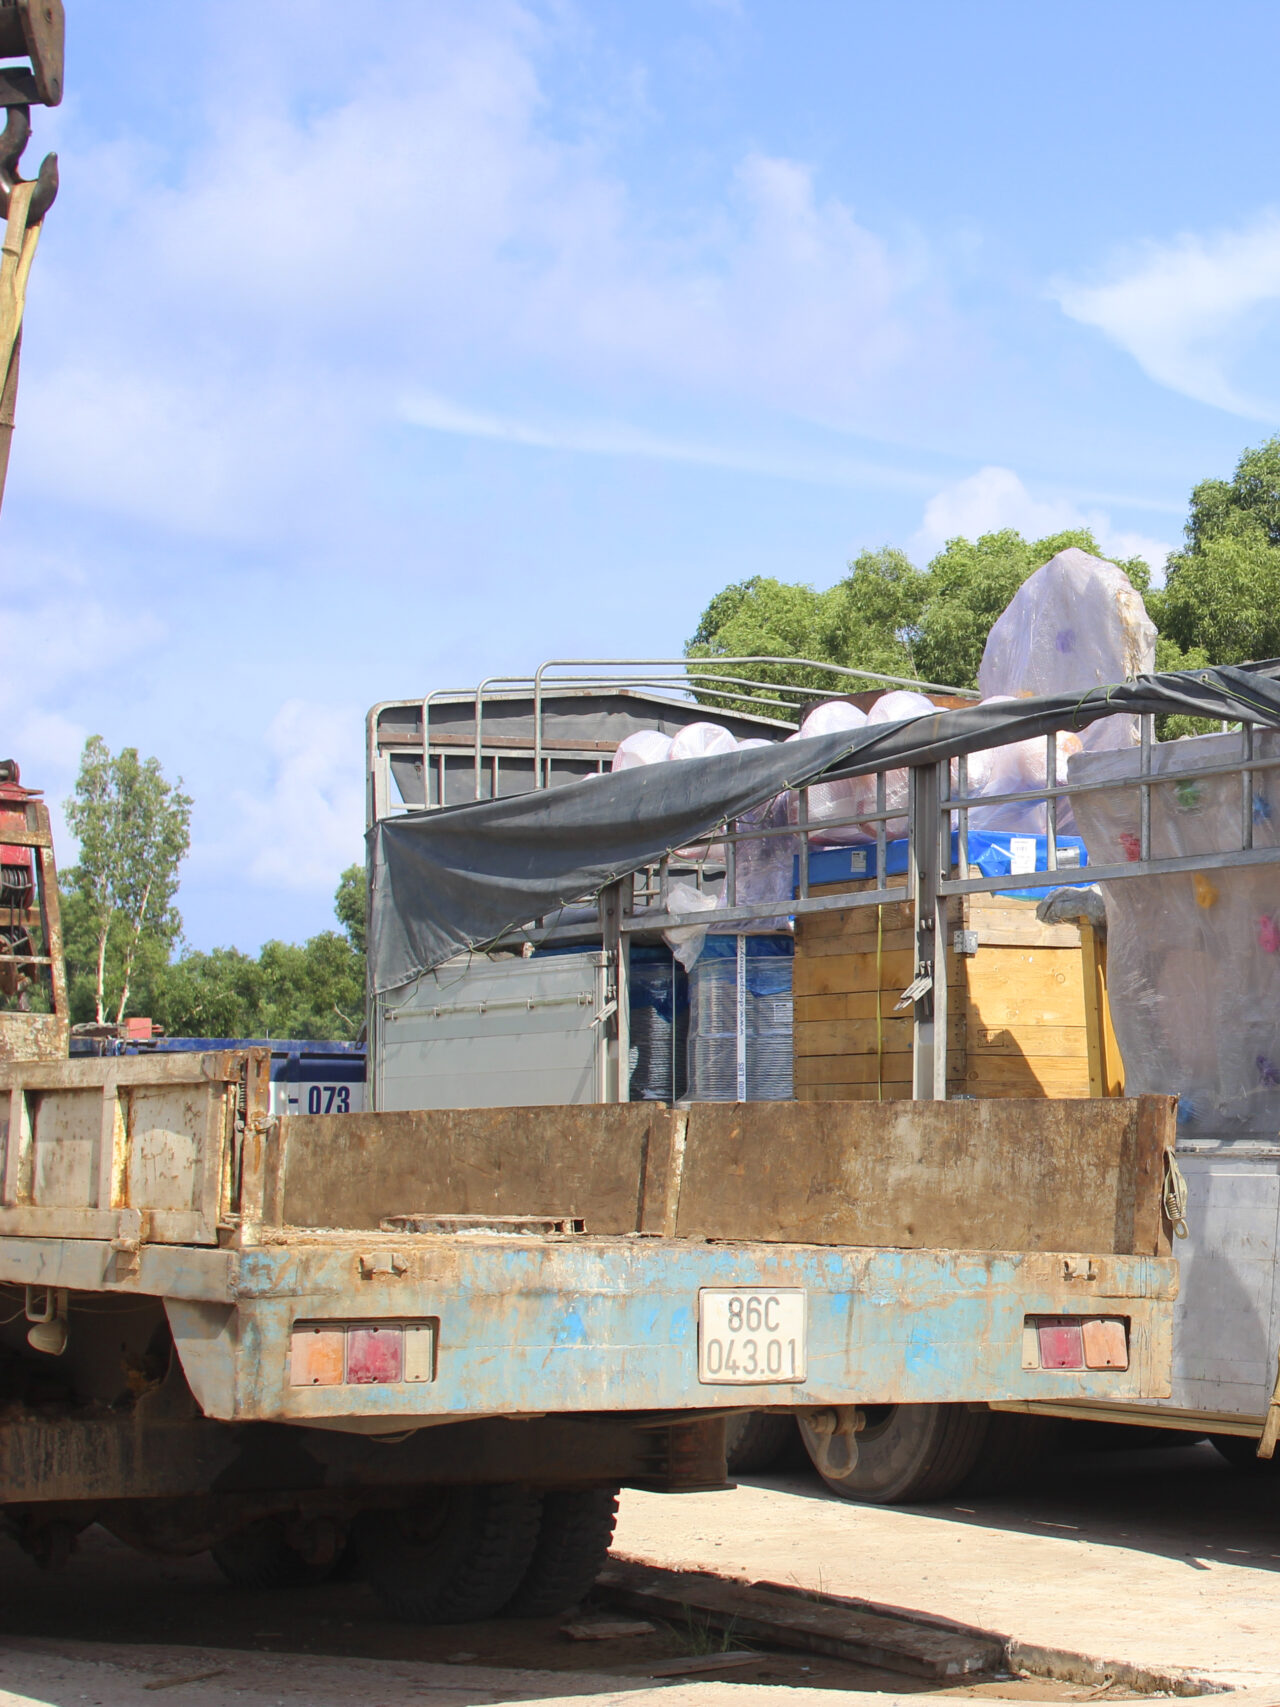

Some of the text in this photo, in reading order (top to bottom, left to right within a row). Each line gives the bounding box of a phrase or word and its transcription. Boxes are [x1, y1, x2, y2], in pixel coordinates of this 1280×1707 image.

[308, 1085, 350, 1115] 073
[727, 1296, 780, 1332] 86C
[707, 1338, 796, 1375] 043.01
